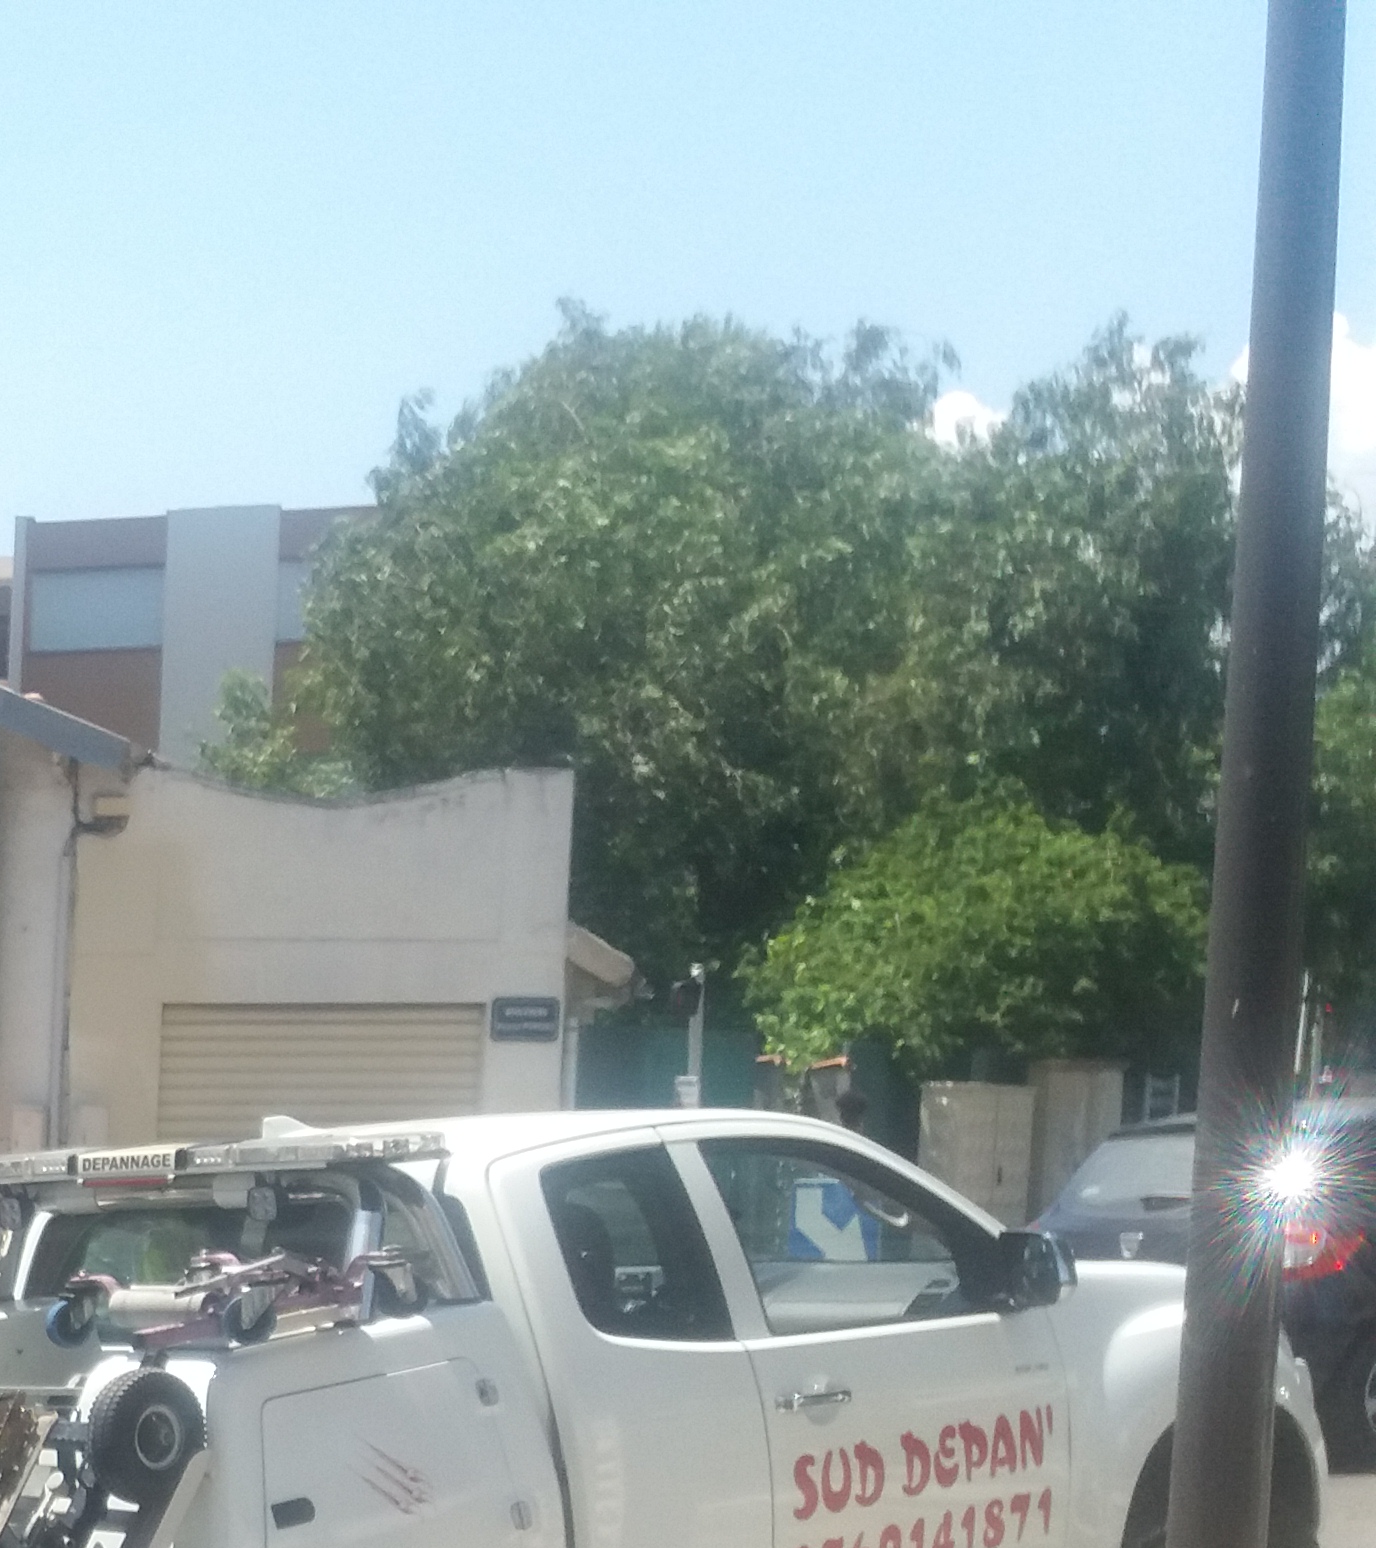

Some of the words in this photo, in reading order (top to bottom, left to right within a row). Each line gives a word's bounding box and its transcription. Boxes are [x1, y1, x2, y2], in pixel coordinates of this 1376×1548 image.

[82, 1153, 171, 1172] DEPANNAGE
[793, 1439, 884, 1520] SUD
[900, 1404, 1053, 1497] DEPAN'
